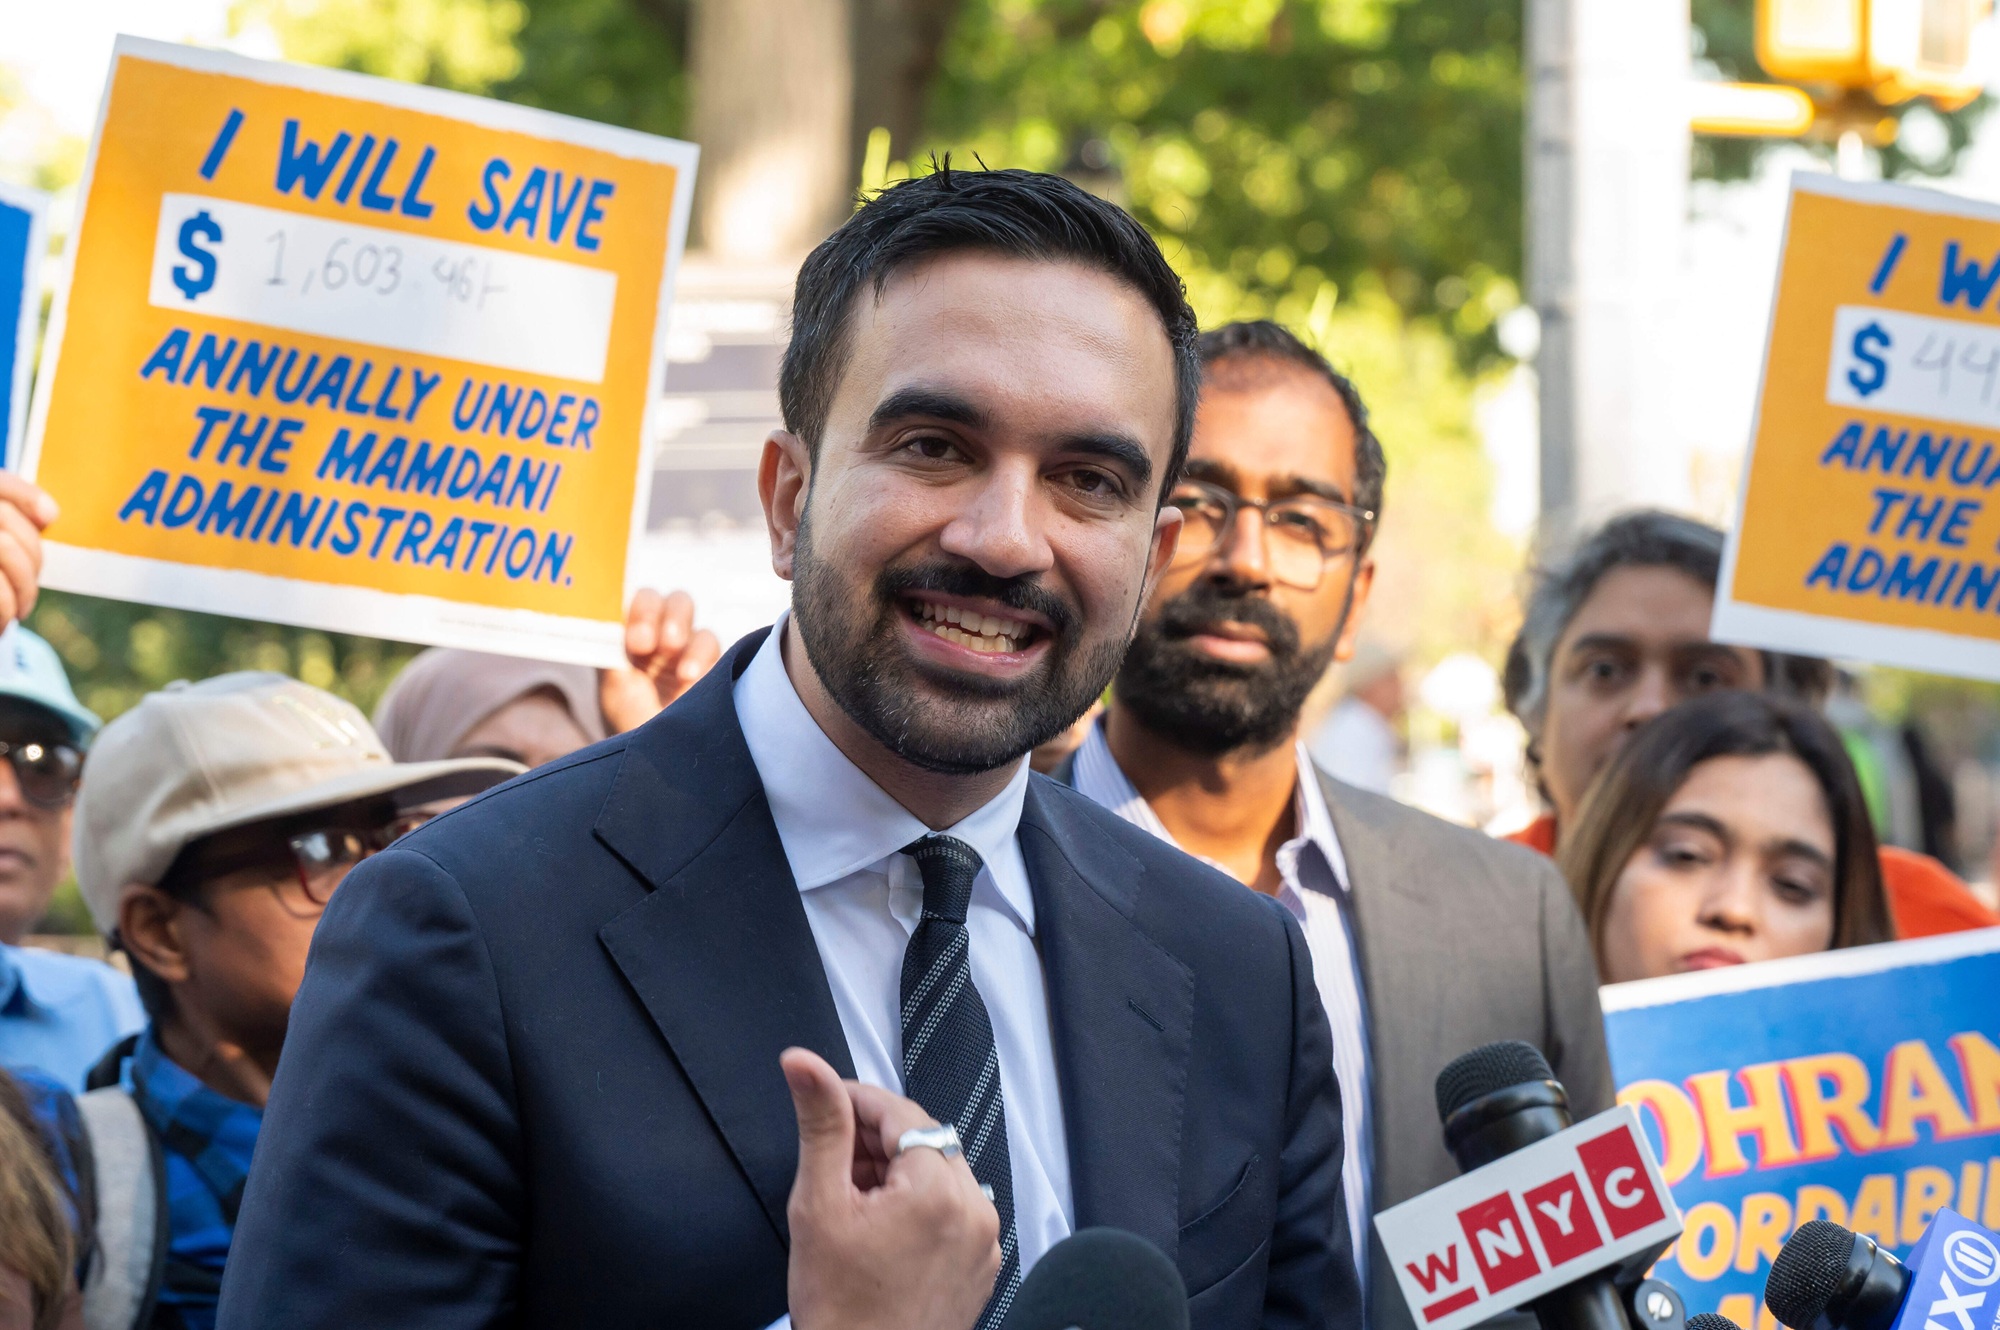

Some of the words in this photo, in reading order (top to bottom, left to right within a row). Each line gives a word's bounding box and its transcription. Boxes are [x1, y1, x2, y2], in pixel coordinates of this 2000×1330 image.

[199, 109, 245, 180] I
[275, 119, 436, 219] WILL
[467, 158, 615, 252] SAVE
[171, 209, 225, 301] $
[1869, 233, 1909, 296] I
[1939, 239, 2000, 311] W
[140, 328, 441, 423] ANNUALLY
[453, 378, 600, 450] UNDER
[1846, 321, 1893, 399] $
[1910, 330, 2000, 410] 44
[189, 406, 305, 474] THE
[316, 428, 562, 513] MAMDANI
[118, 470, 574, 587] ADMINISTRATION.
[1868, 488, 1983, 548] THE
[1805, 543, 2000, 613] ADMIN
[1404, 1166, 1645, 1295] WNYC
